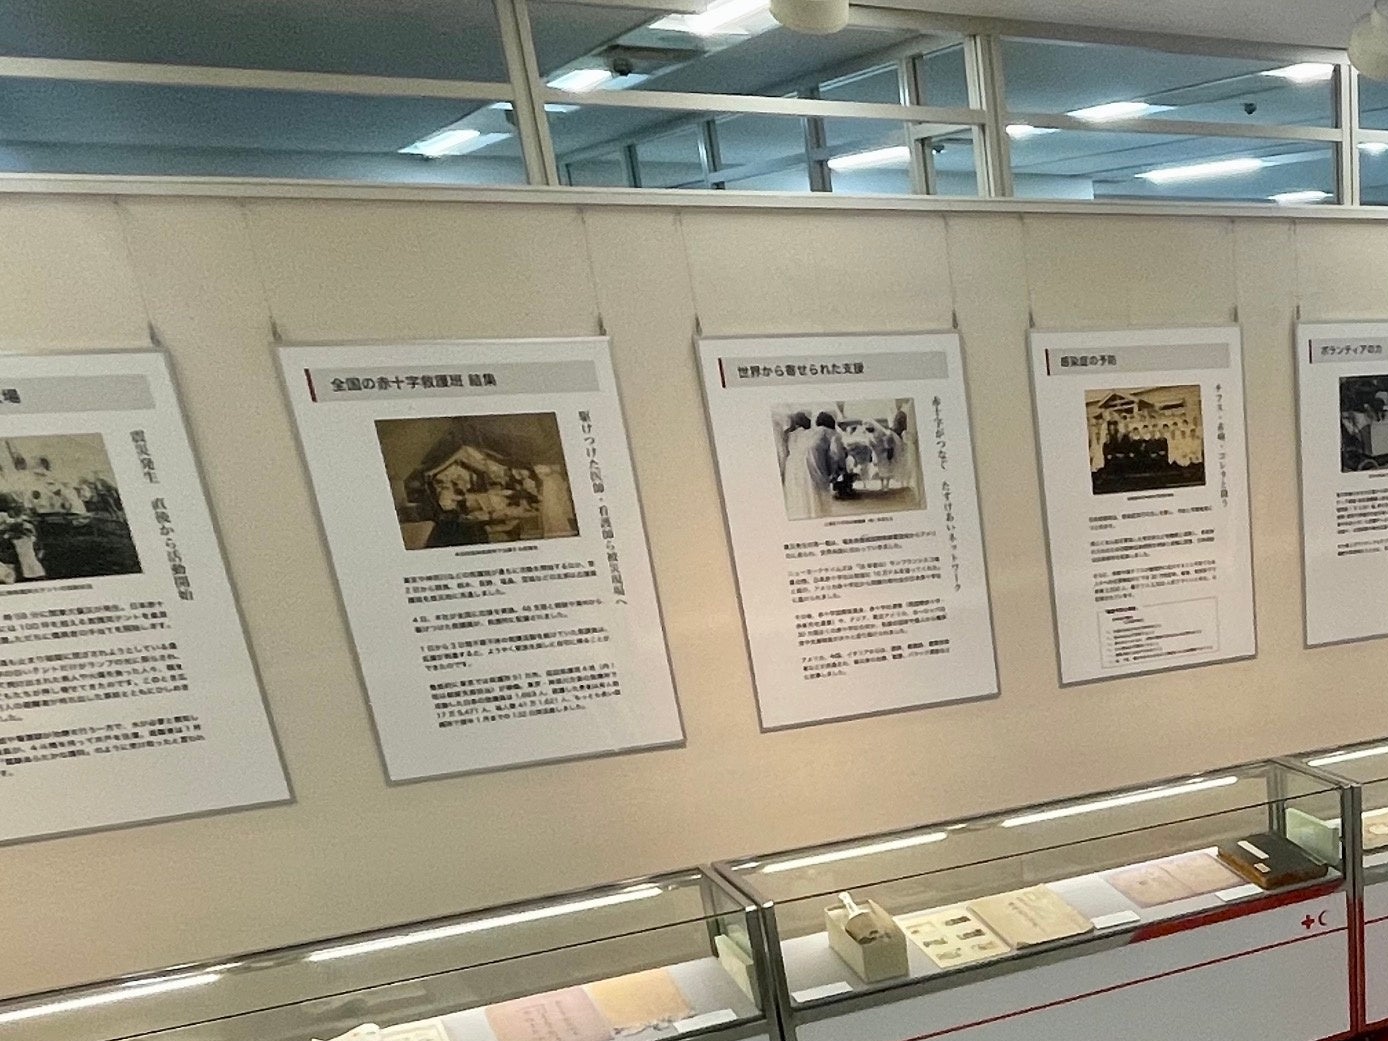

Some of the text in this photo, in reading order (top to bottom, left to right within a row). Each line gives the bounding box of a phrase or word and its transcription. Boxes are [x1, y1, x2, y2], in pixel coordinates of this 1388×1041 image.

[737, 361, 865, 379] 世界から寄せられた支援
[330, 372, 497, 392] 全国の赤十字救護班 結集
